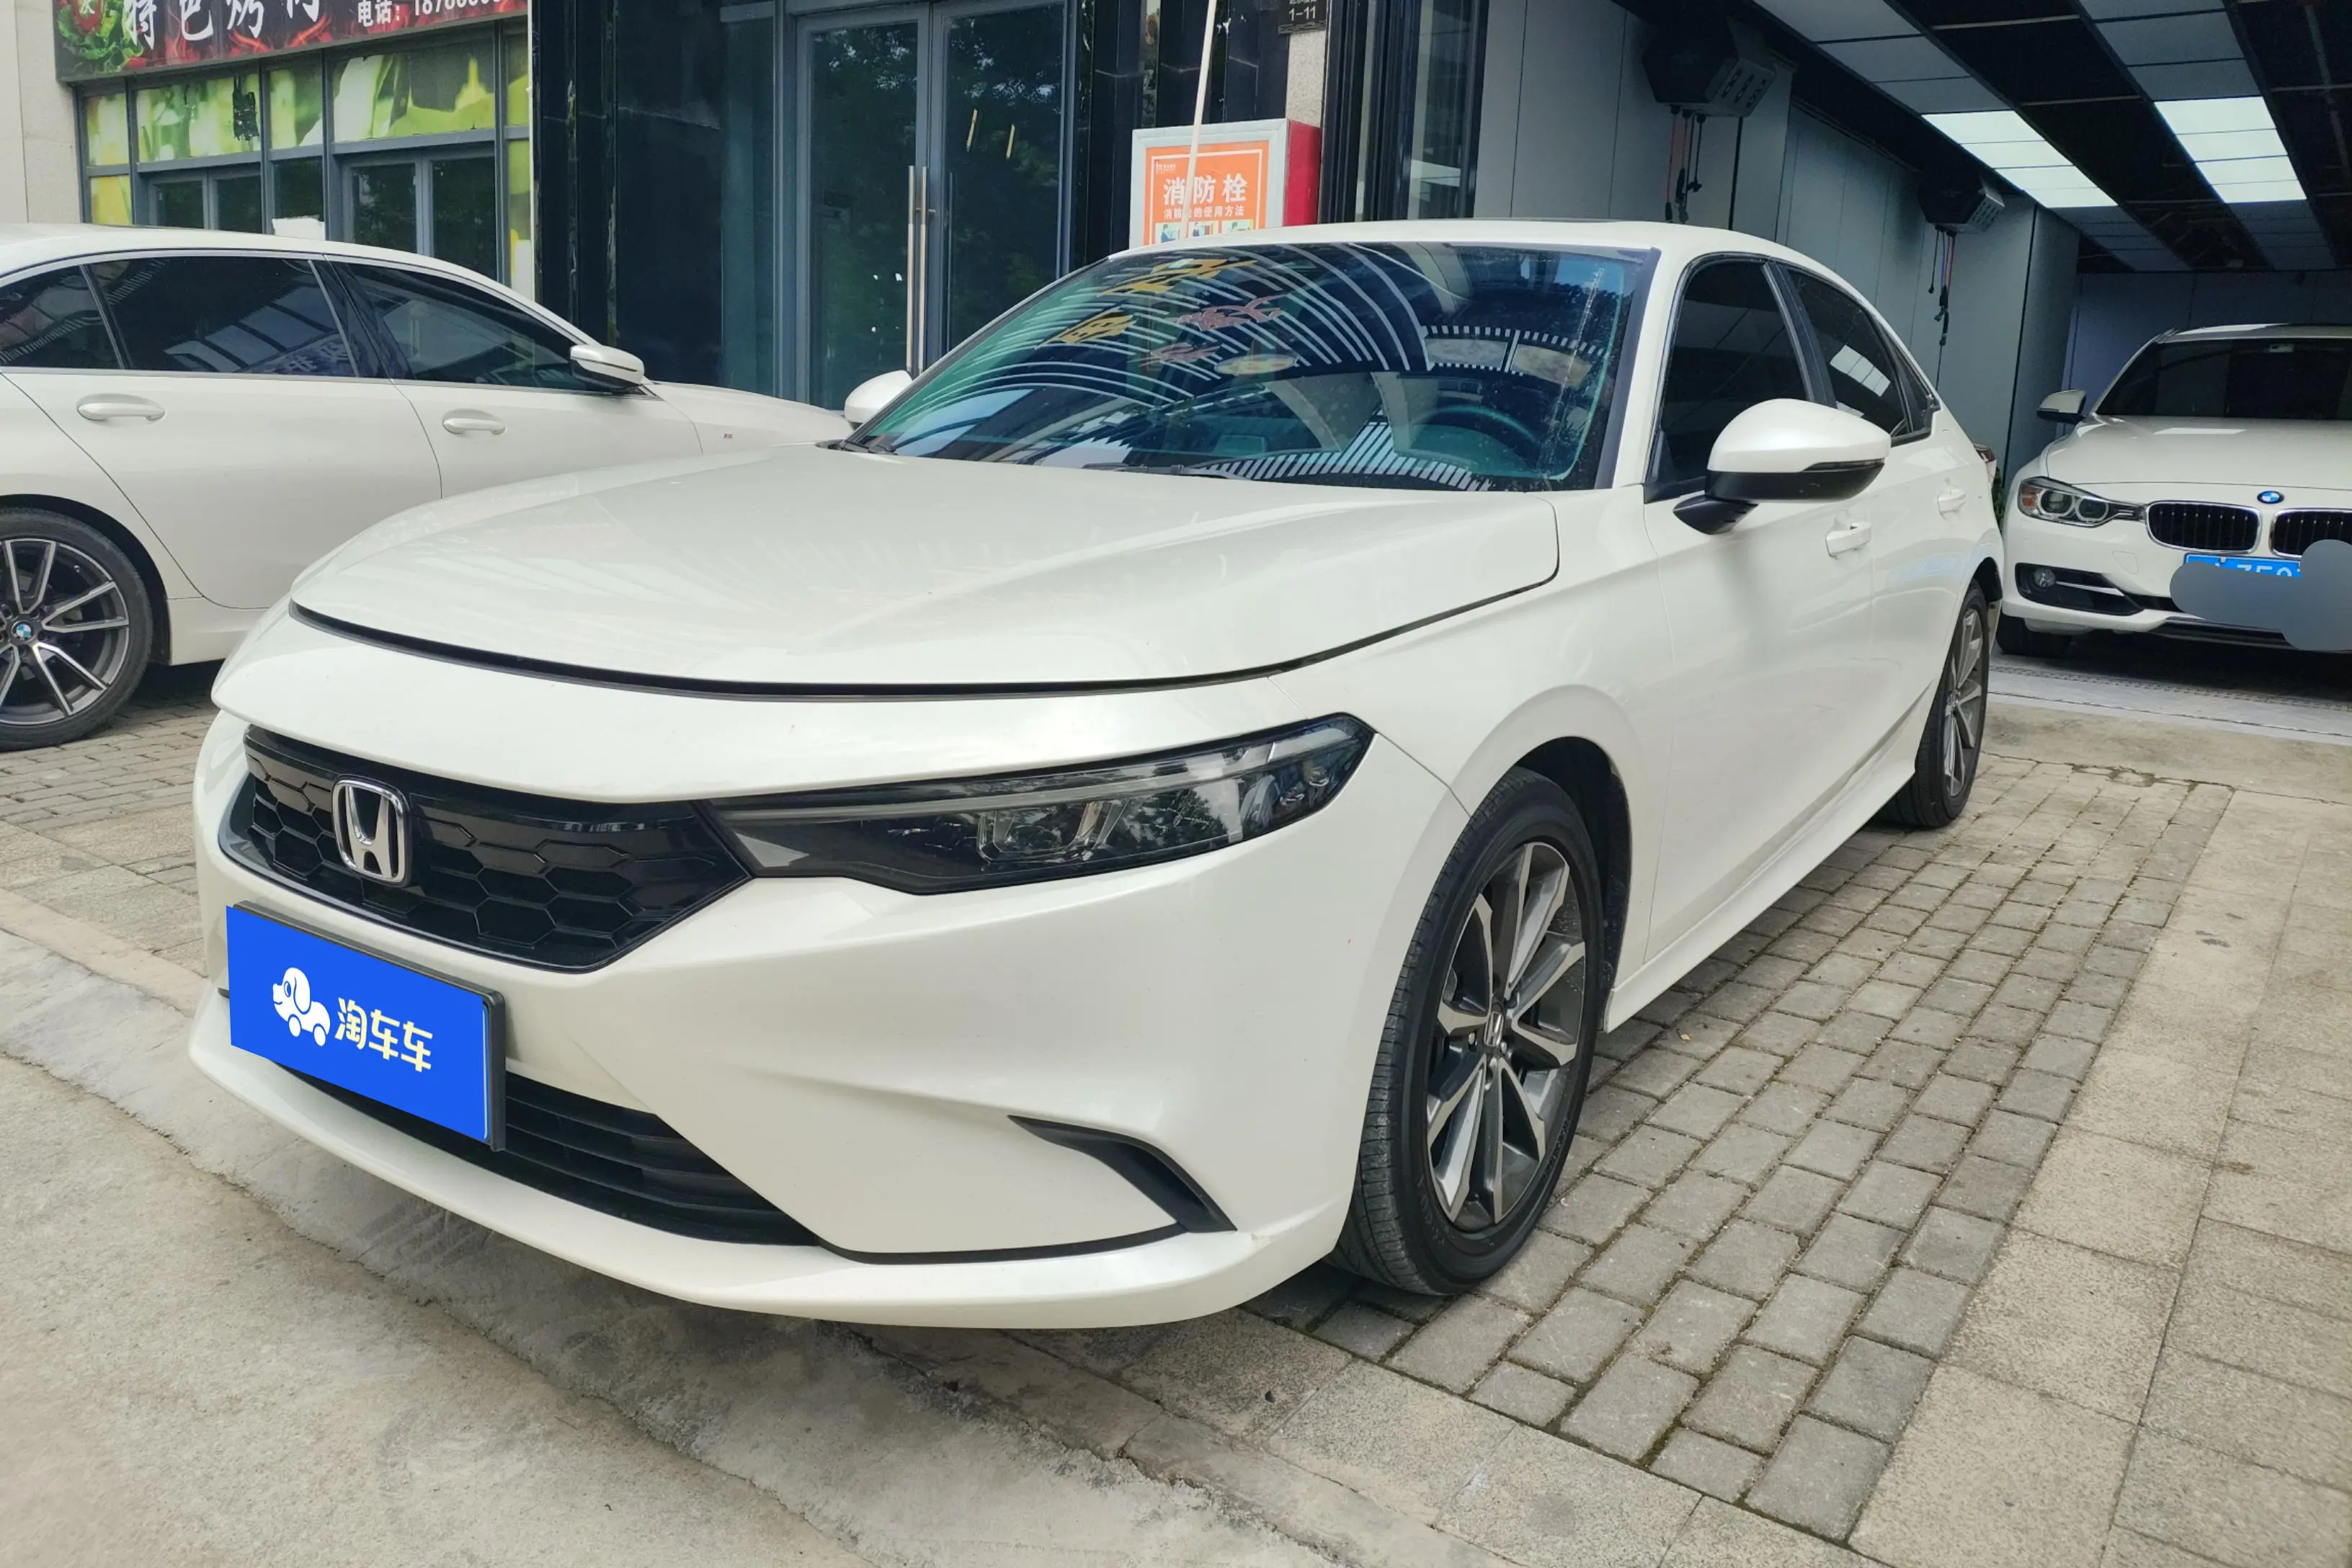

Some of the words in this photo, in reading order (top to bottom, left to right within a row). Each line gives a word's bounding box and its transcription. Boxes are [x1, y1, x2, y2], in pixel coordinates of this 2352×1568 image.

[1288, 5, 1317, 22] 1-11
[1163, 173, 1248, 205] 消防栓
[1164, 205, 1245, 220] 消防的使用方法
